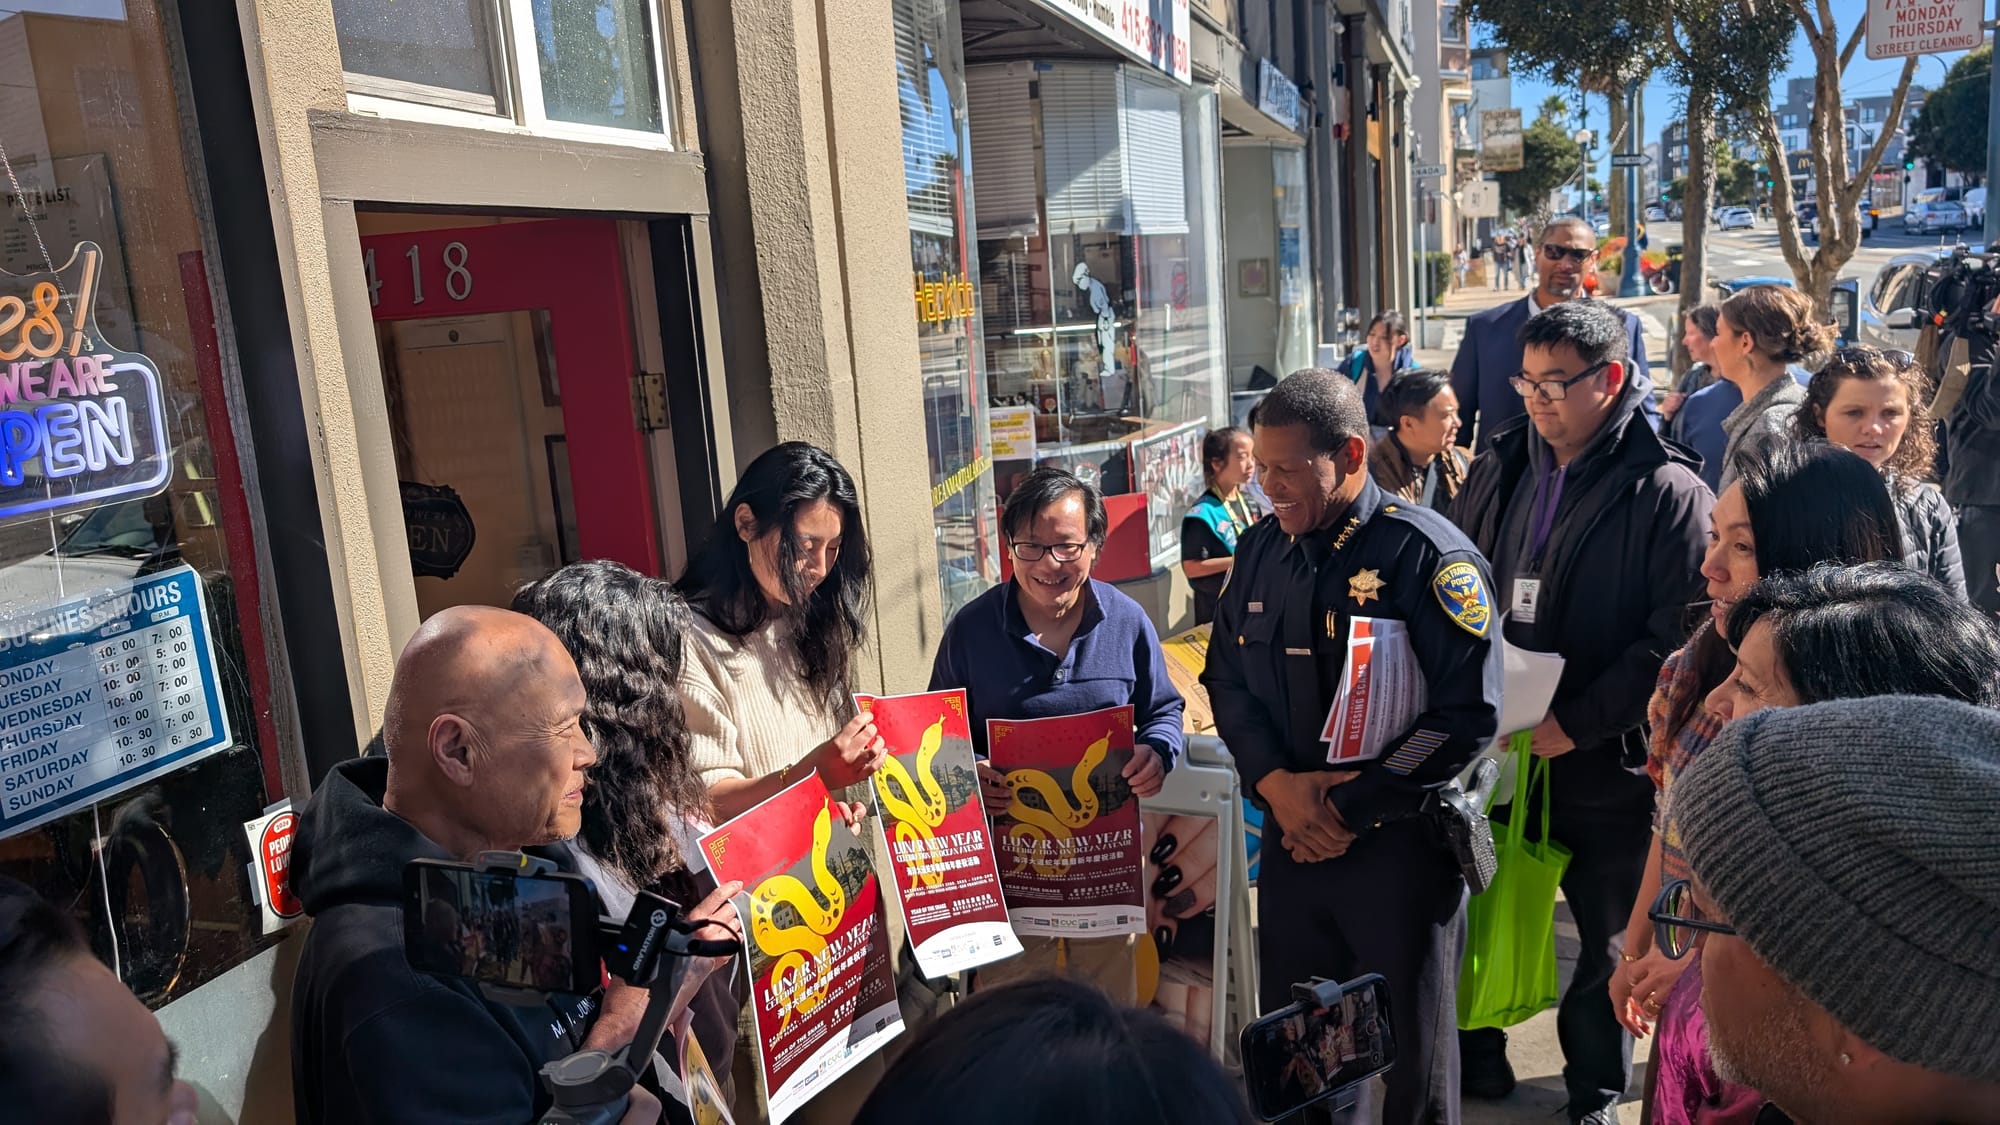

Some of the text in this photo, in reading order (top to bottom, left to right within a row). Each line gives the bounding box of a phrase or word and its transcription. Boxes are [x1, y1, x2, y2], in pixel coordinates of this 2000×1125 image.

[1896, 4, 1955, 23] MONDAY
[1888, 17, 1963, 39] THURSDAY
[1875, 34, 1973, 55] STREET CLEANING
[45, 187, 71, 203] LIST
[912, 270, 976, 333] Hapkido
[47, 353, 119, 399] ARE
[0, 395, 135, 487] PEN
[1438, 572, 1452, 586] SAN
[1451, 575, 1473, 588] POLICE
[111, 580, 183, 620] HOURS
[108, 610, 172, 635] A.M. P.M.
[122, 638, 136, 651] 00
[169, 626, 183, 639] 00
[126, 656, 140, 669] 00
[174, 641, 187, 654] 00
[127, 672, 141, 684] 00
[173, 657, 186, 669] 00
[1356, 663, 1368, 695] SCAMS
[129, 690, 143, 703] 00
[174, 675, 188, 688] 00
[1349, 696, 1365, 740] BLESSING
[1, 740, 59, 773] FRIDAY
[135, 709, 149, 721] 00
[177, 693, 191, 706] 00
[4, 749, 89, 791] SATURDAY
[138, 727, 152, 740] 30
[181, 711, 195, 723] 00
[9, 774, 75, 811] SUNDAY
[142, 745, 156, 758] 30
[189, 726, 202, 739] 30
[893, 829, 983, 855] LUNAR NEW YEAR
[1002, 829, 1133, 849] LUNAR NEW YEAR
[910, 906, 922, 915] YEAR
[922, 905, 928, 913] OF
[935, 903, 948, 911] SNAKE
[633, 926, 657, 971] HOLLYLAND
[763, 960, 811, 1003] LUNAR
[813, 935, 844, 965] NEW
[846, 912, 878, 944] YEAR
[765, 969, 816, 1011] CELEBRATION
[817, 960, 829, 974] ON
[830, 943, 853, 965] OCEAN
[853, 924, 880, 948] AVENUE
[774, 1020, 825, 1062] YEAR OF THE SNAKE
